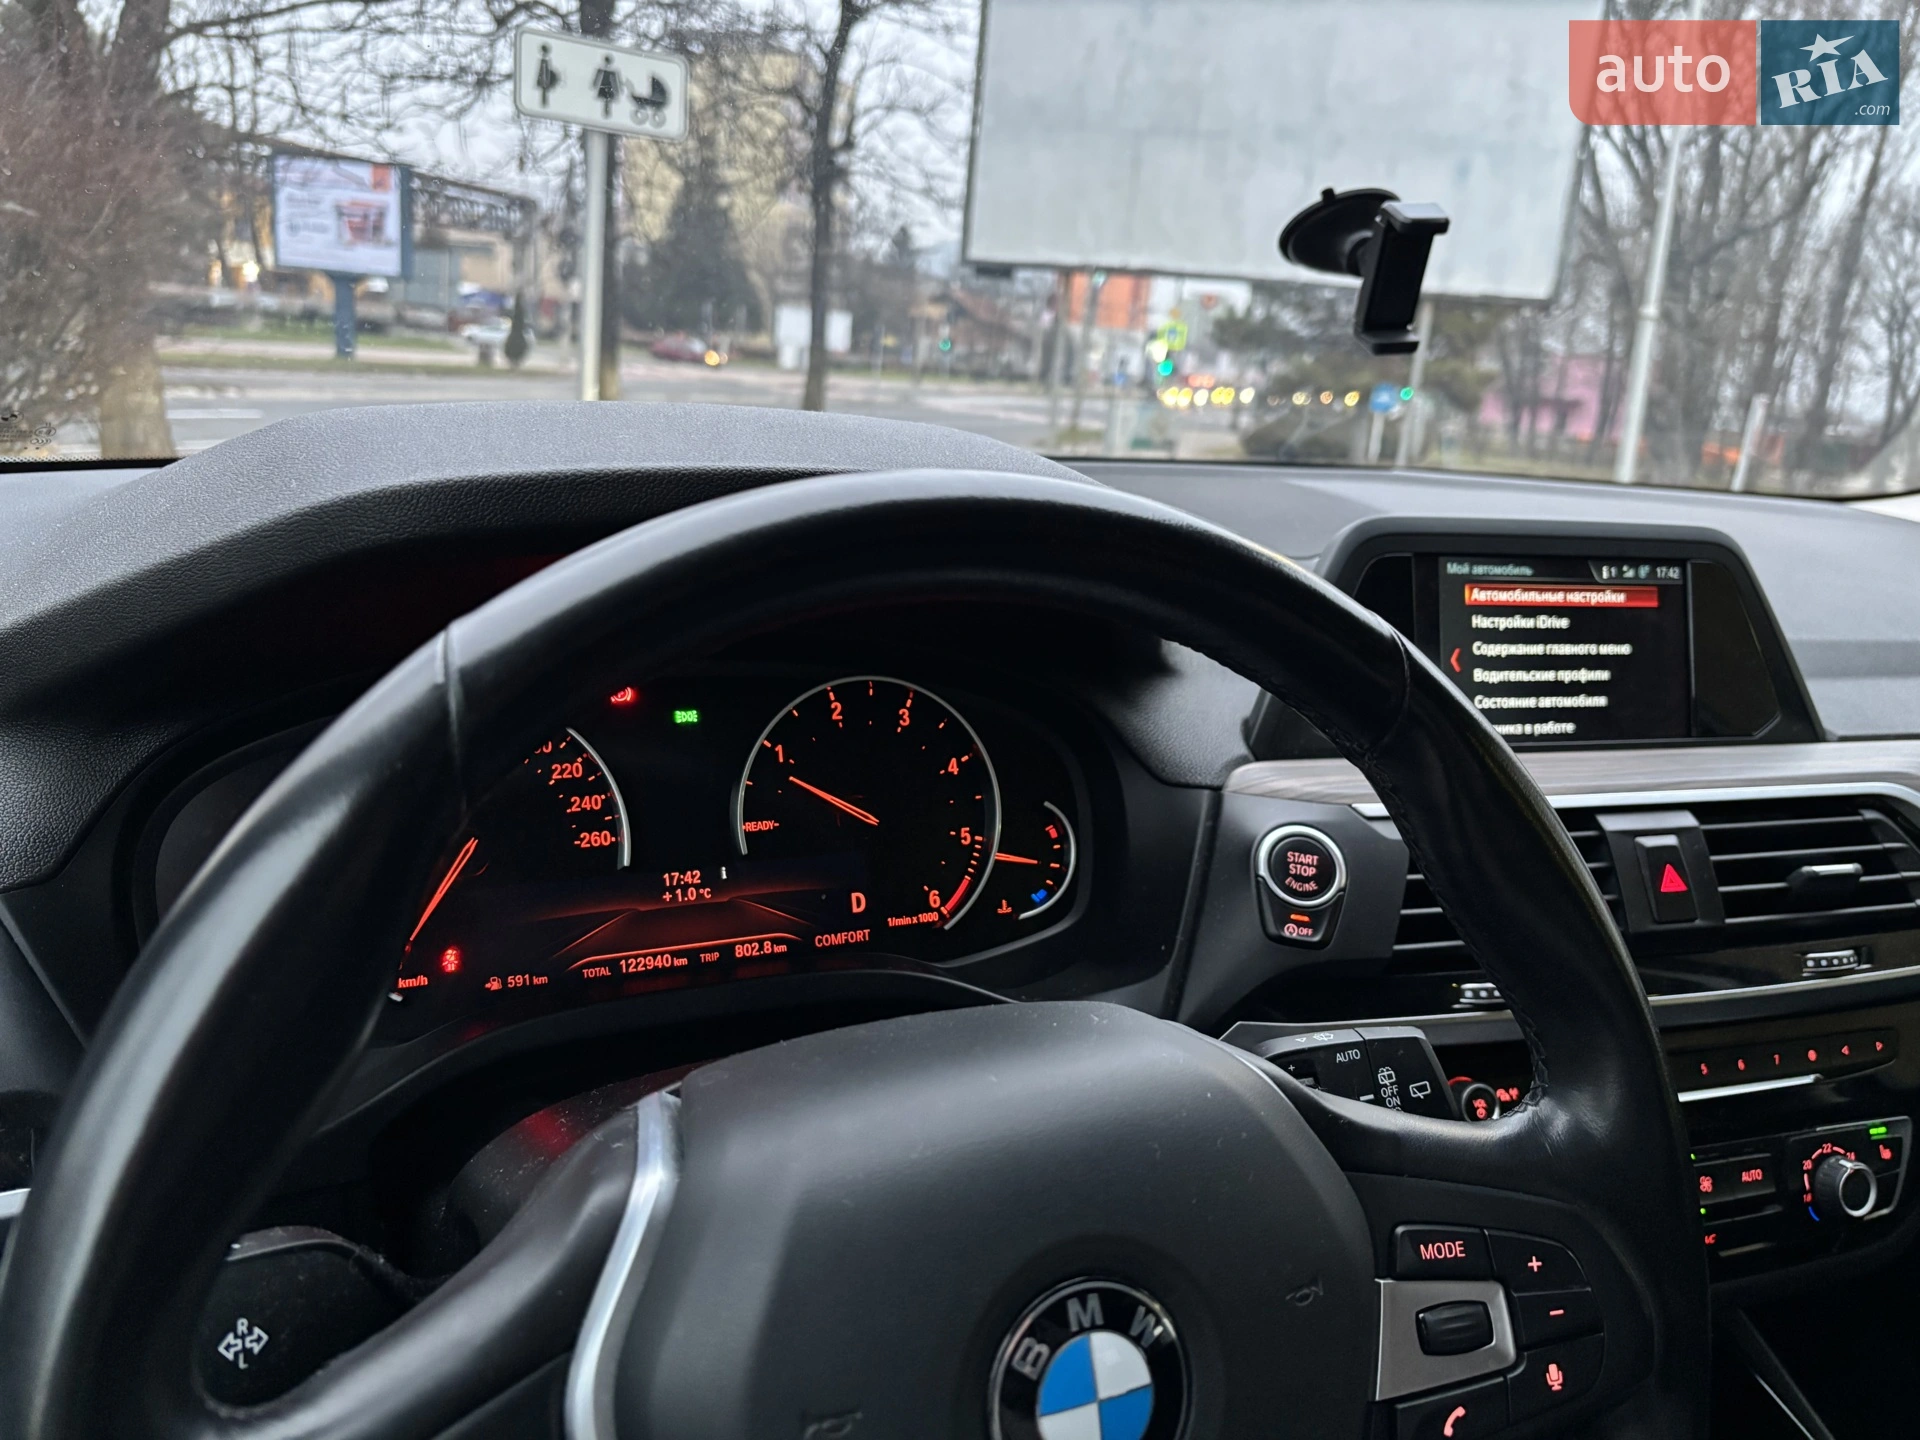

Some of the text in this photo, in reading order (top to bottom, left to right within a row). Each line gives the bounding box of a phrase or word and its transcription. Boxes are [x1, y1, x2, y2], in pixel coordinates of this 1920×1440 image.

[1446, 562, 1534, 576] Мой автомобиль
[1656, 565, 1681, 580] 17:42
[1471, 587, 1627, 606] Автомобильные настройки
[1471, 614, 1571, 632] Настройки iDrive
[1472, 641, 1633, 658] Содержание главного меню
[1473, 667, 1612, 684] Водительские профили
[831, 699, 842, 720] 2
[1474, 693, 1609, 709] Состояние автомобиля
[899, 706, 910, 726] 3
[1494, 721, 1577, 737] ника в работе
[775, 745, 783, 762] 1
[552, 762, 582, 779] 220
[948, 758, 959, 775] 4
[571, 794, 603, 812] 240
[745, 820, 775, 833] READY
[580, 831, 611, 848] 260
[961, 827, 971, 845] 5
[1287, 852, 1318, 866] START
[663, 870, 701, 888] 17:42
[1287, 863, 1318, 878] STOP
[1285, 877, 1318, 891] ENGINE
[676, 887, 696, 902] 1.0
[699, 888, 711, 899] °C
[851, 892, 866, 913] D
[928, 889, 941, 909] 6
[887, 911, 940, 928] 1/min x 1000
[815, 929, 870, 947] COMFORT
[1298, 926, 1315, 937] OFF
[733, 939, 787, 957] 802.8 km
[583, 952, 688, 978] TOTAL 122940 km
[700, 952, 719, 962] TRIP
[398, 975, 428, 988] km/h
[508, 974, 548, 987] 591 km
[1337, 1049, 1360, 1063] AUTO
[1701, 1064, 1708, 1074] 5
[1379, 1084, 1399, 1098] OFF
[1384, 1094, 1402, 1108] ON
[1821, 1142, 1833, 1154] 22
[1803, 1158, 1813, 1170] 20
[1742, 1169, 1762, 1182] AUTO
[1420, 1241, 1465, 1259] MODE
[236, 1317, 249, 1336] R
[1010, 1292, 1165, 1381] BMW
[238, 1353, 248, 1369] L
